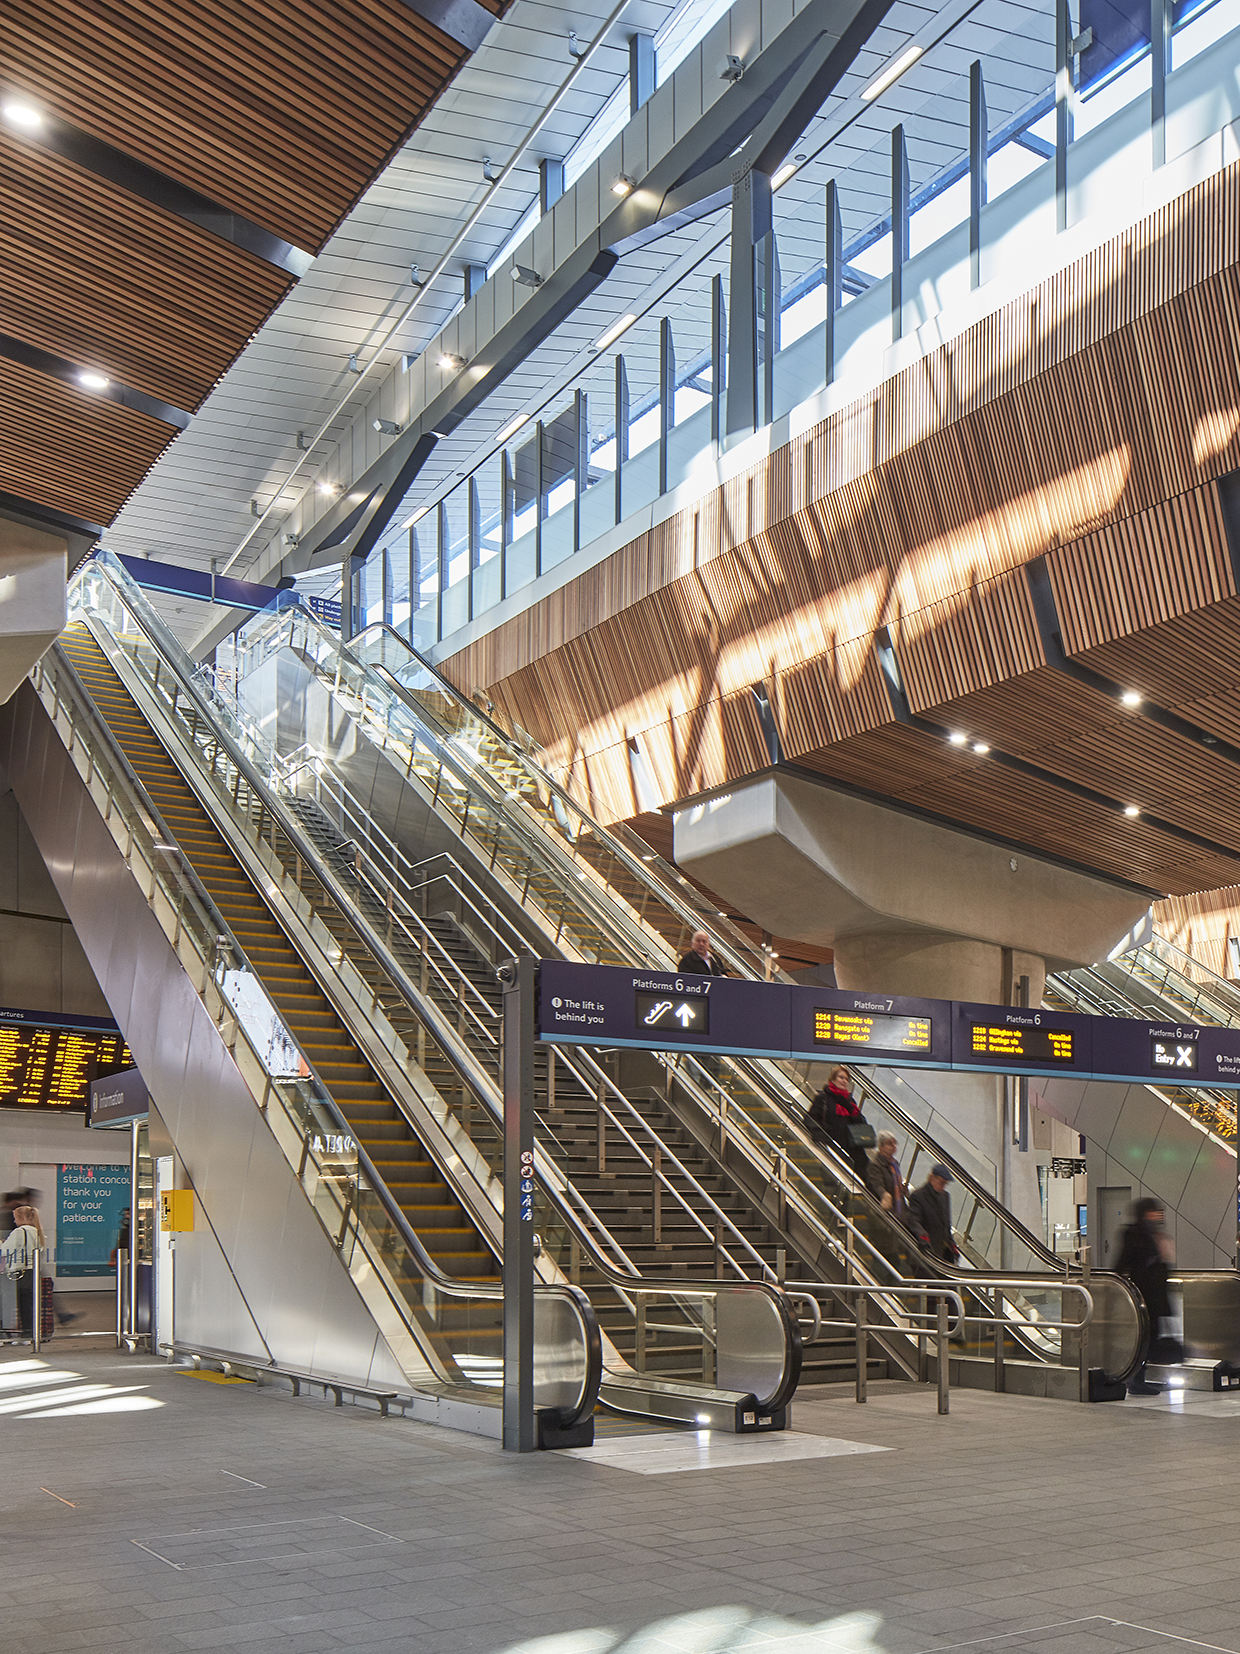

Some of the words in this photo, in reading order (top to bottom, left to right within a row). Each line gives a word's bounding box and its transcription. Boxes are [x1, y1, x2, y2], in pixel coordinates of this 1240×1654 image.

[632, 978, 673, 992] Platforms
[675, 978, 684, 992] 6
[685, 984, 701, 994] and
[702, 981, 712, 994] 7
[564, 999, 581, 1009] The
[582, 1000, 596, 1010] lift
[596, 1002, 605, 1011] is
[854, 1000, 885, 1011] Platform
[886, 1000, 894, 1011] 7
[555, 1012, 586, 1022] behind
[587, 1015, 605, 1025] you
[1006, 1014, 1033, 1024] Platform
[1034, 1014, 1041, 1025] 6
[908, 1021, 916, 1029] On
[908, 1030, 916, 1038] On
[1013, 1030, 1022, 1038] via
[1048, 1032, 1072, 1042] Cancelled
[1149, 1028, 1175, 1038] Platforms
[1176, 1027, 1182, 1038] 6
[1183, 1031, 1193, 1039] and
[1194, 1029, 1200, 1040] 7
[902, 1038, 929, 1047] Cancelled
[1010, 1038, 1019, 1046] via
[1015, 1046, 1024, 1054] via
[1155, 1044, 1166, 1053] No
[1155, 1054, 1175, 1065] Entry
[1223, 1055, 1233, 1064] The
[1233, 1056, 1240, 1064] lift
[1218, 1065, 1236, 1074] behind
[99, 1090, 124, 1109] Information
[62, 1175, 97, 1184] station
[63, 1187, 91, 1197] thank
[93, 1189, 112, 1198] you
[62, 1200, 77, 1209] for
[81, 1202, 103, 1211] your
[62, 1213, 105, 1223] patience.
